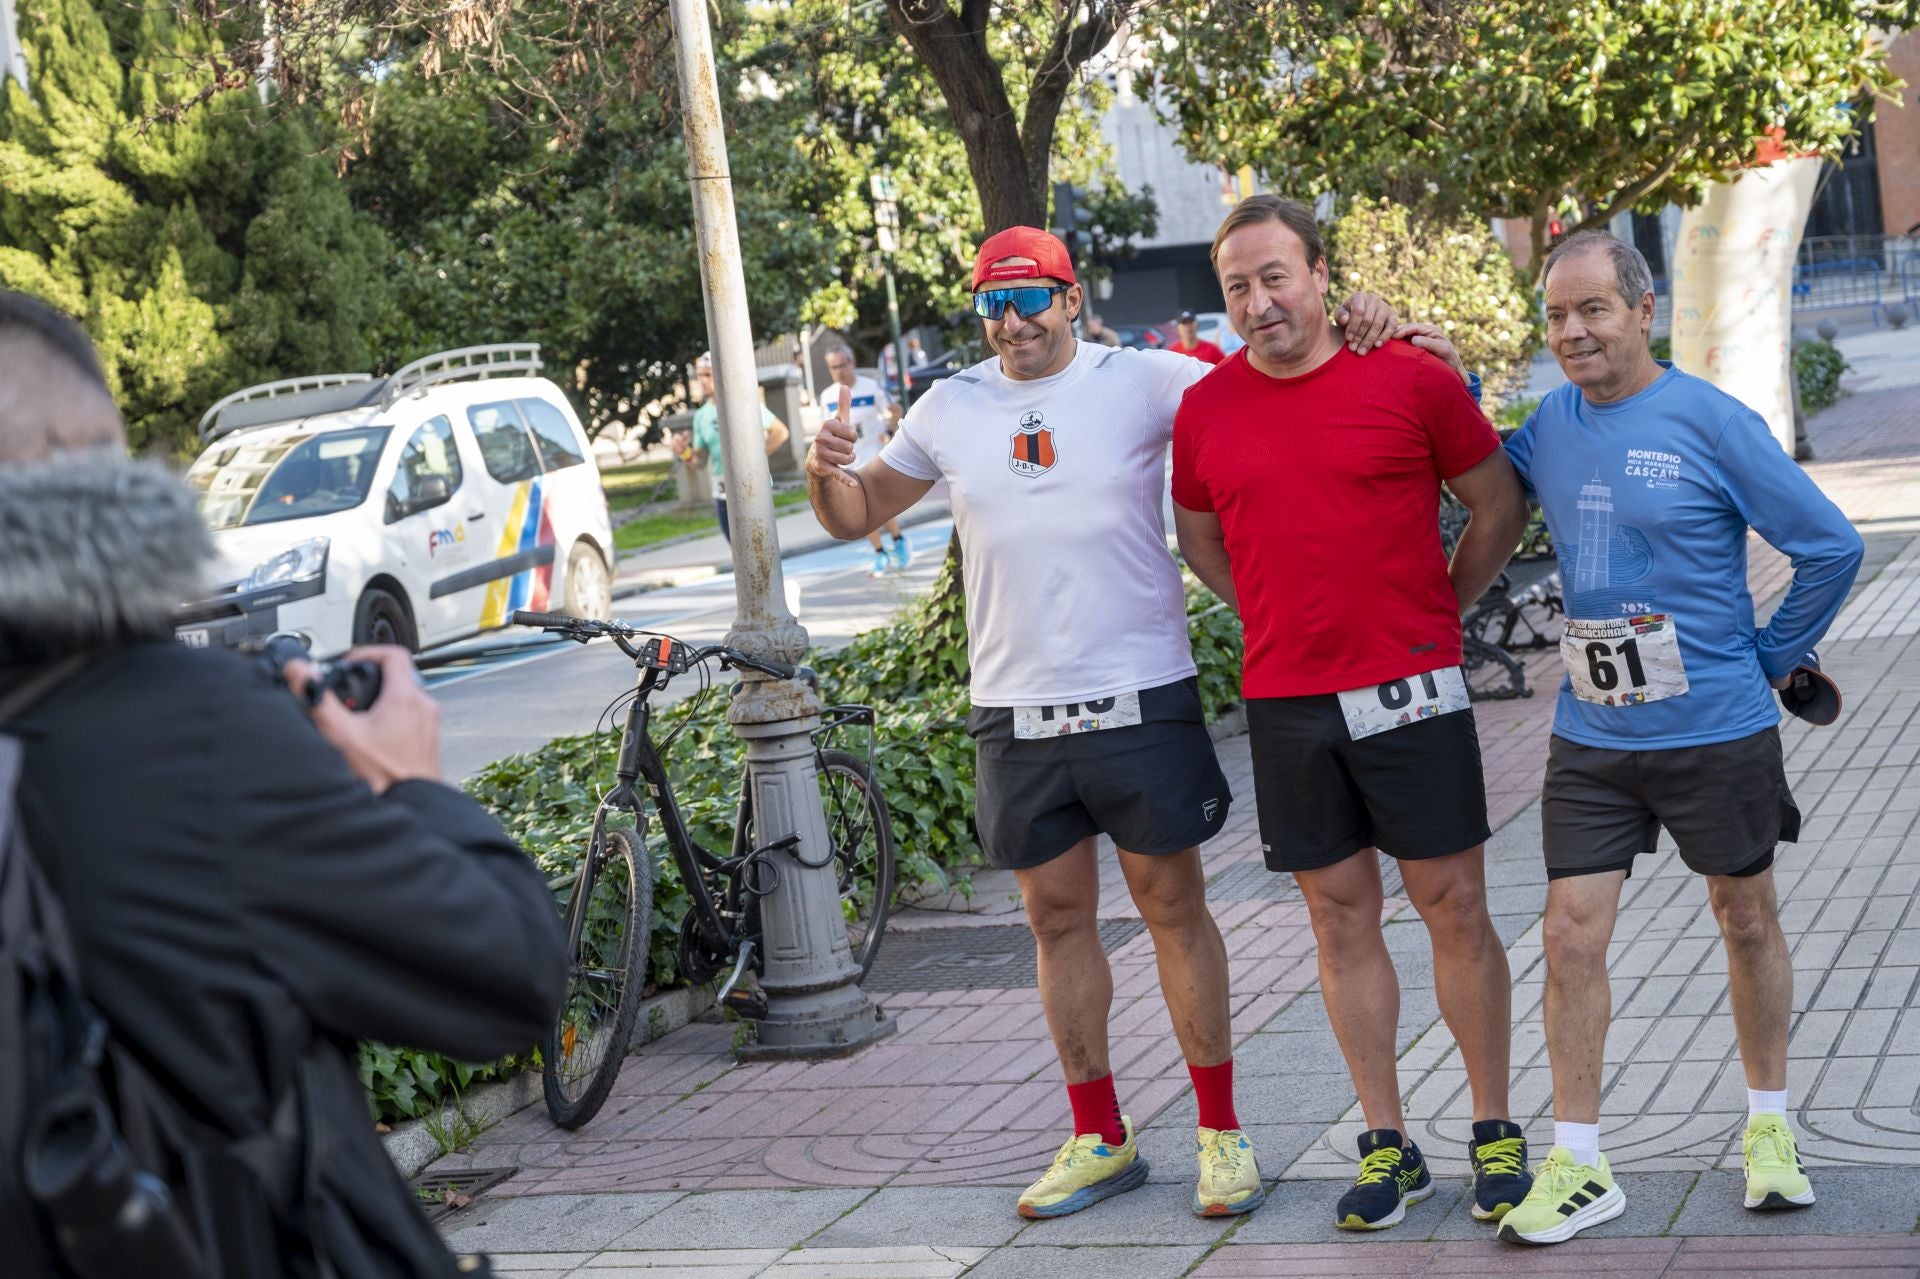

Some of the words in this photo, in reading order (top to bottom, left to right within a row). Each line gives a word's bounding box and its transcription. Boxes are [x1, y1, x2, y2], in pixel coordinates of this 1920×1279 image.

[1627, 448, 1682, 464] MONTEPIO
[1625, 465, 1680, 480] CASCAIS
[1644, 460, 1679, 470] MARATONA
[1621, 602, 1652, 614] 2025
[1585, 637, 1647, 691] 61
